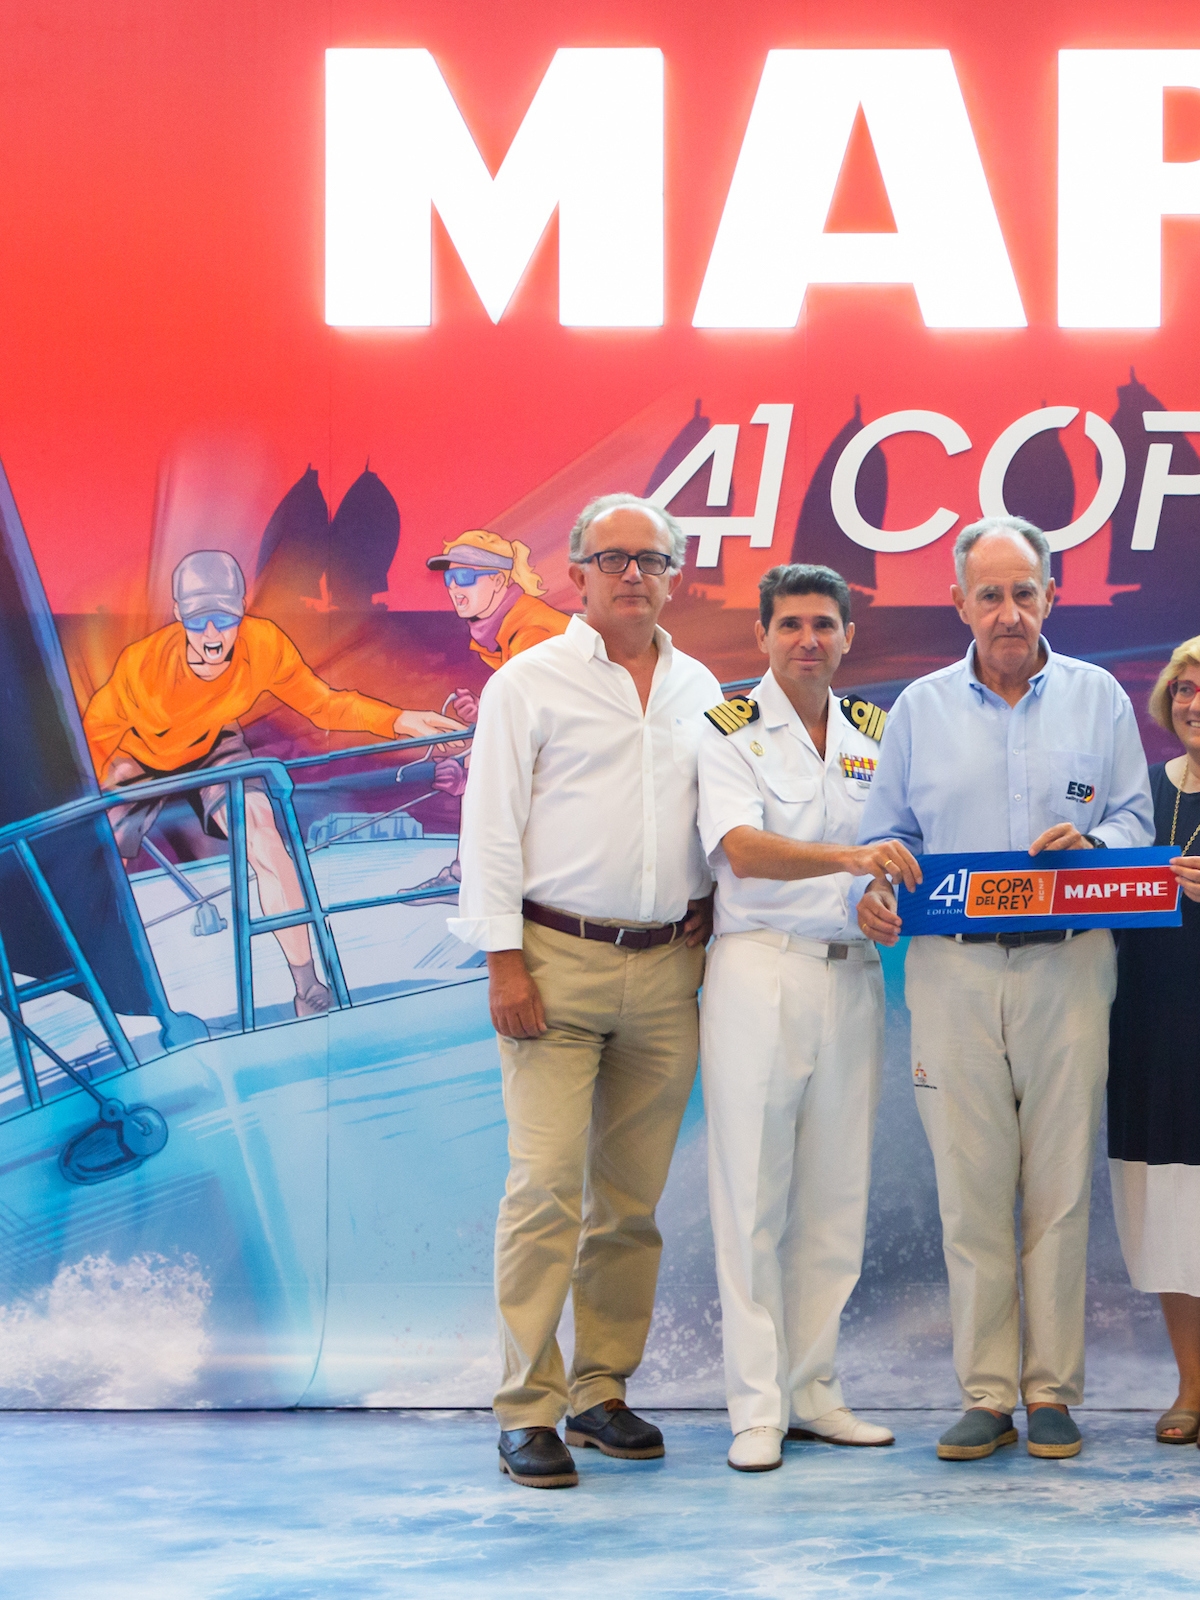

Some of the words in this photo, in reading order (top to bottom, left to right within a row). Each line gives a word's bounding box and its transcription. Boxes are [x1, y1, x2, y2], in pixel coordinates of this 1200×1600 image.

[649, 403, 794, 568] 41
[929, 868, 968, 907] 41
[981, 878, 1034, 894] COPA
[1064, 881, 1168, 899] MAPFRE
[976, 896, 995, 906] DEL
[997, 894, 1033, 910] REY
